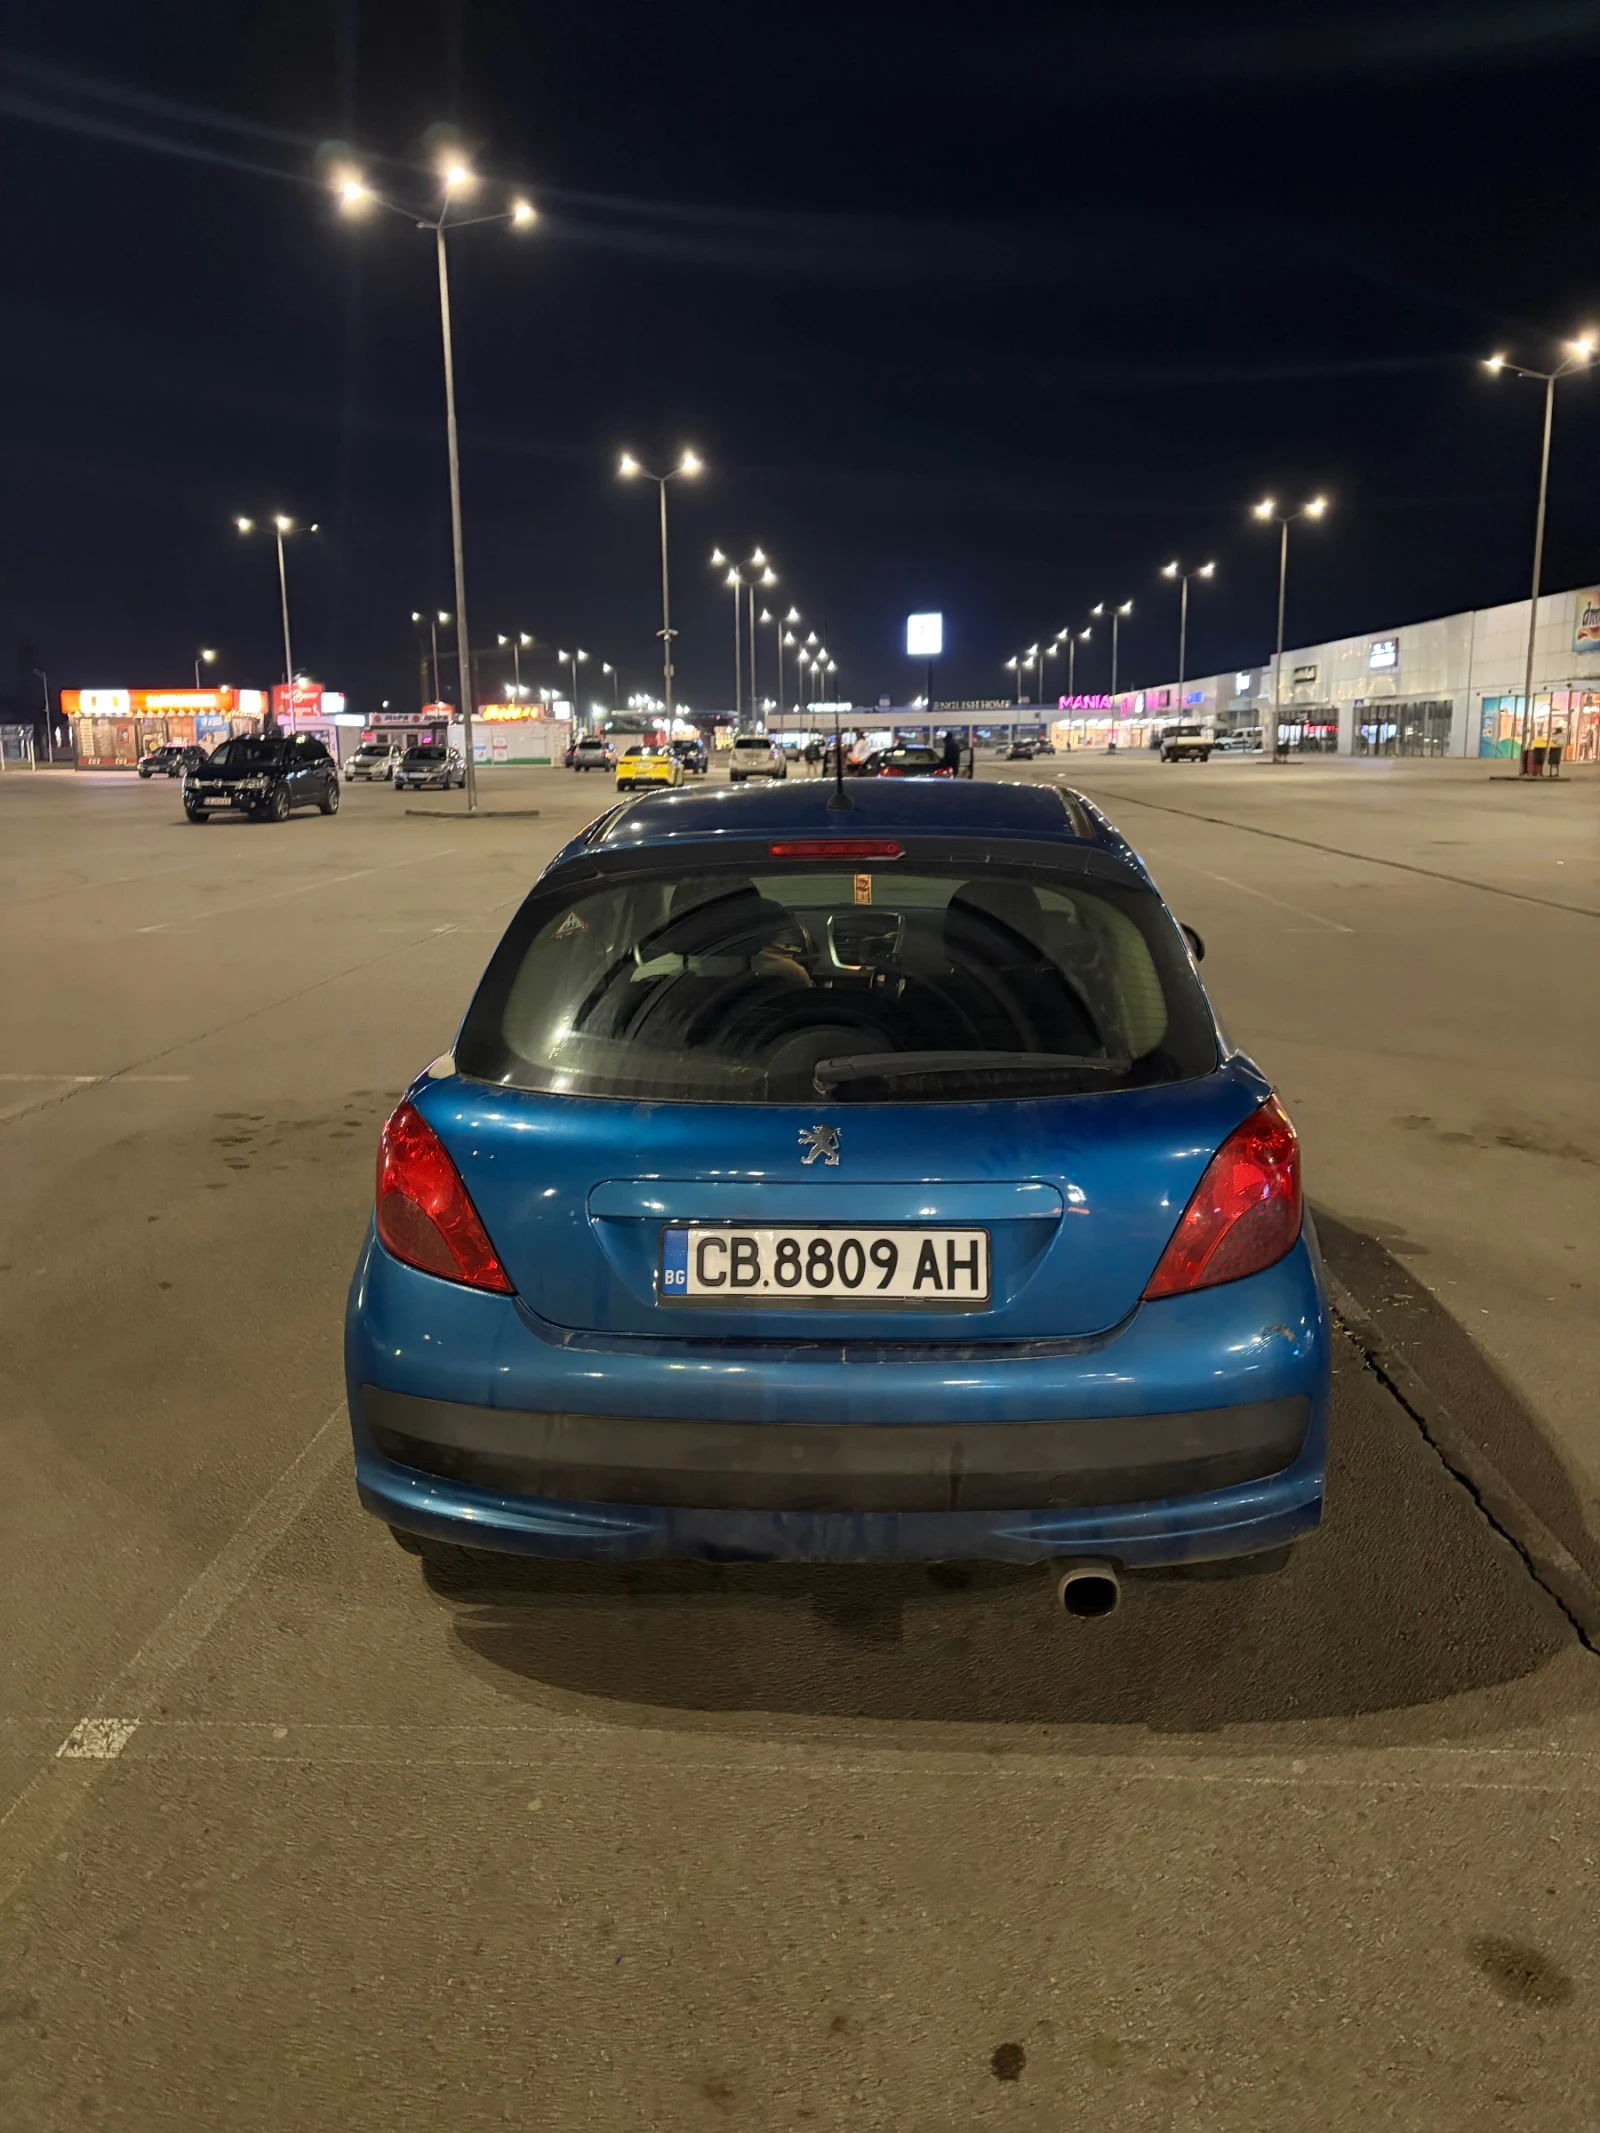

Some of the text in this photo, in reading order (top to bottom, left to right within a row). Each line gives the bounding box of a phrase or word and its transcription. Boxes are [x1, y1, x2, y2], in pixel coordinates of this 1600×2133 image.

[934, 699, 1011, 710] ENGLISH HOME
[1059, 694, 1112, 710] MANIA
[912, 1239, 979, 1290] AH
[664, 1269, 686, 1285] BG
